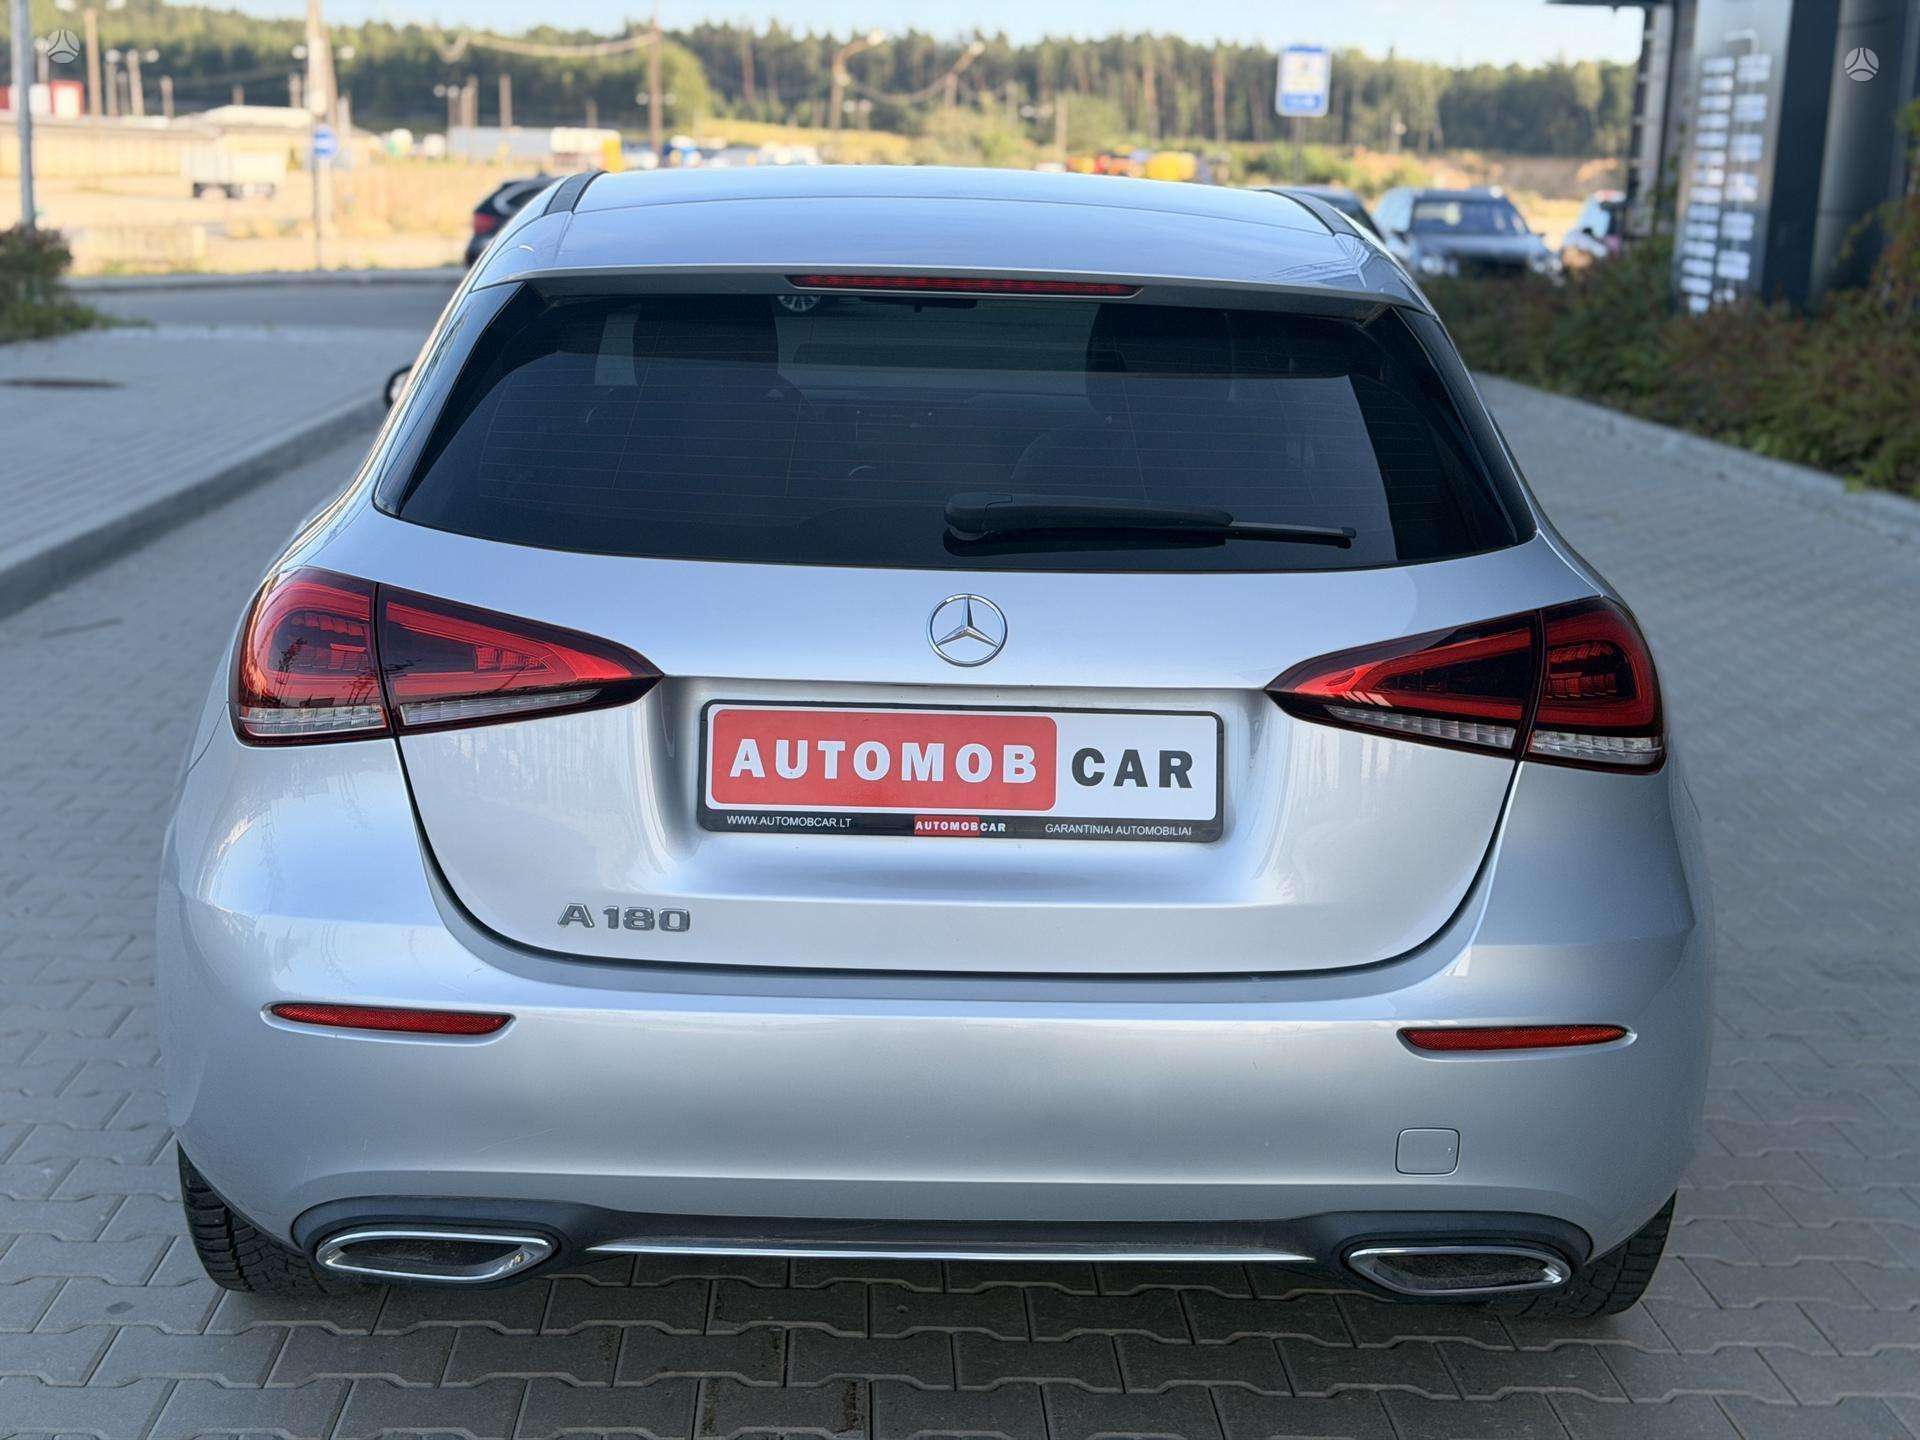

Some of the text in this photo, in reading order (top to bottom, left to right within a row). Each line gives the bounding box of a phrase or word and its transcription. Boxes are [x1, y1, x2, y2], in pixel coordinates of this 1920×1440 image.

[729, 738, 1193, 788] AUTOMOB CAR
[726, 815, 852, 828] WWW.AUTOMOBCAR.LT
[915, 820, 1006, 832] AUTOMOBCAR
[1044, 823, 1192, 836] GARANTINIAI AUTOMOBILIAI
[557, 902, 691, 932] A 180
